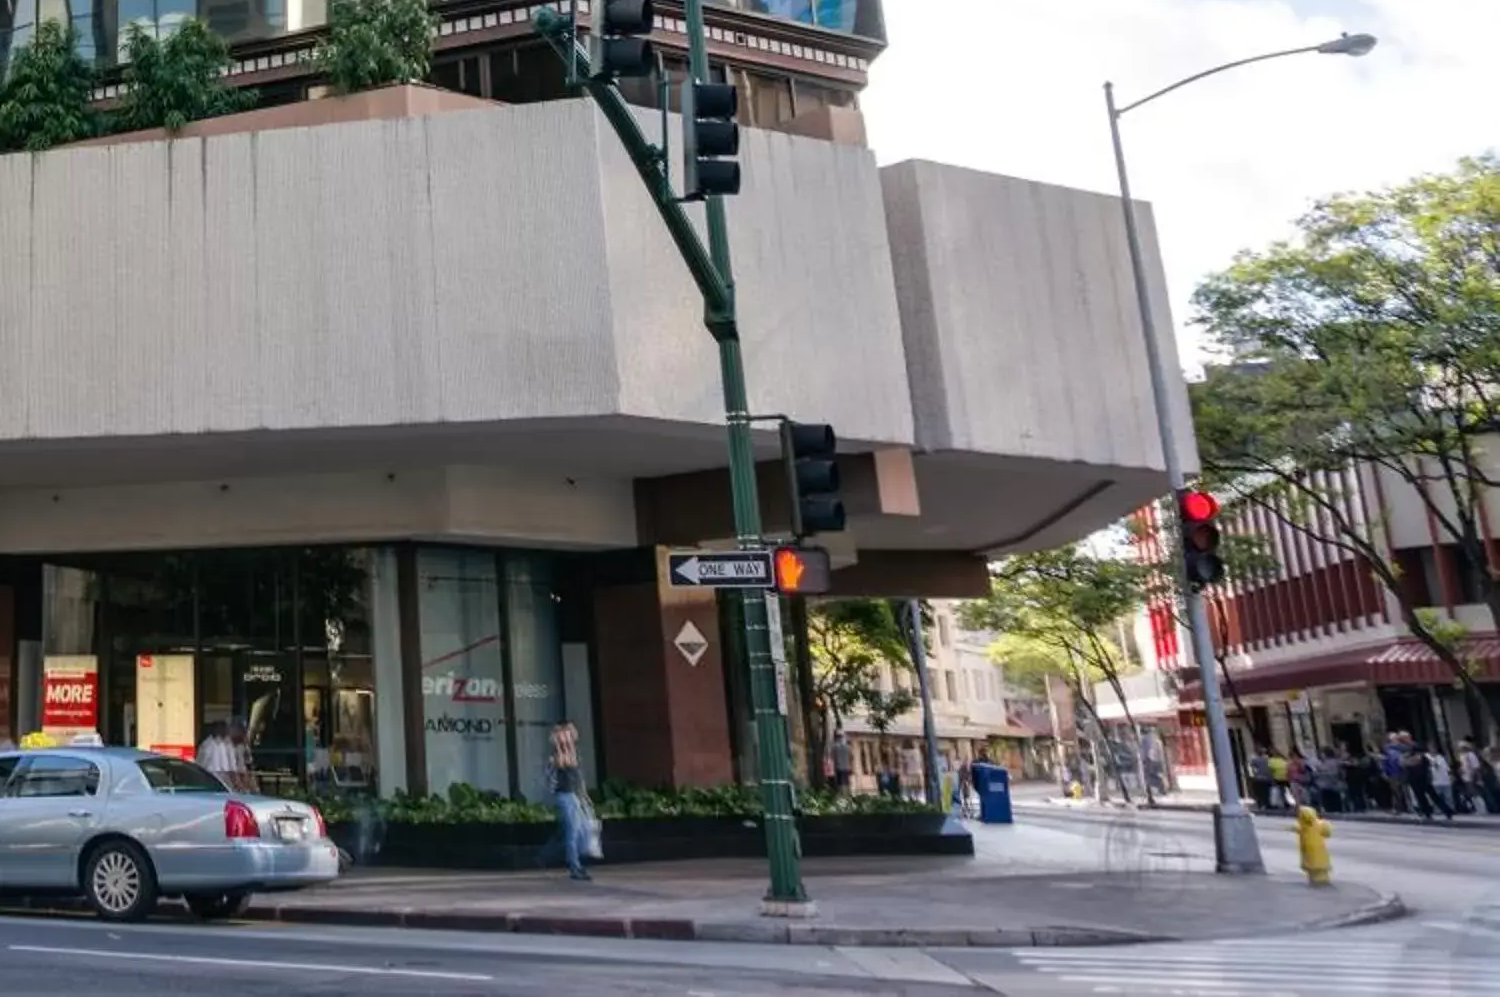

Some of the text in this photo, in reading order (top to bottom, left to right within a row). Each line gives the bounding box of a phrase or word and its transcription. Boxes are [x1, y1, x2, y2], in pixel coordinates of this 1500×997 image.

[698, 562, 761, 576] ONE WAY
[46, 684, 94, 704] MORE
[422, 671, 497, 702] erizon
[423, 713, 492, 734] AMOND
